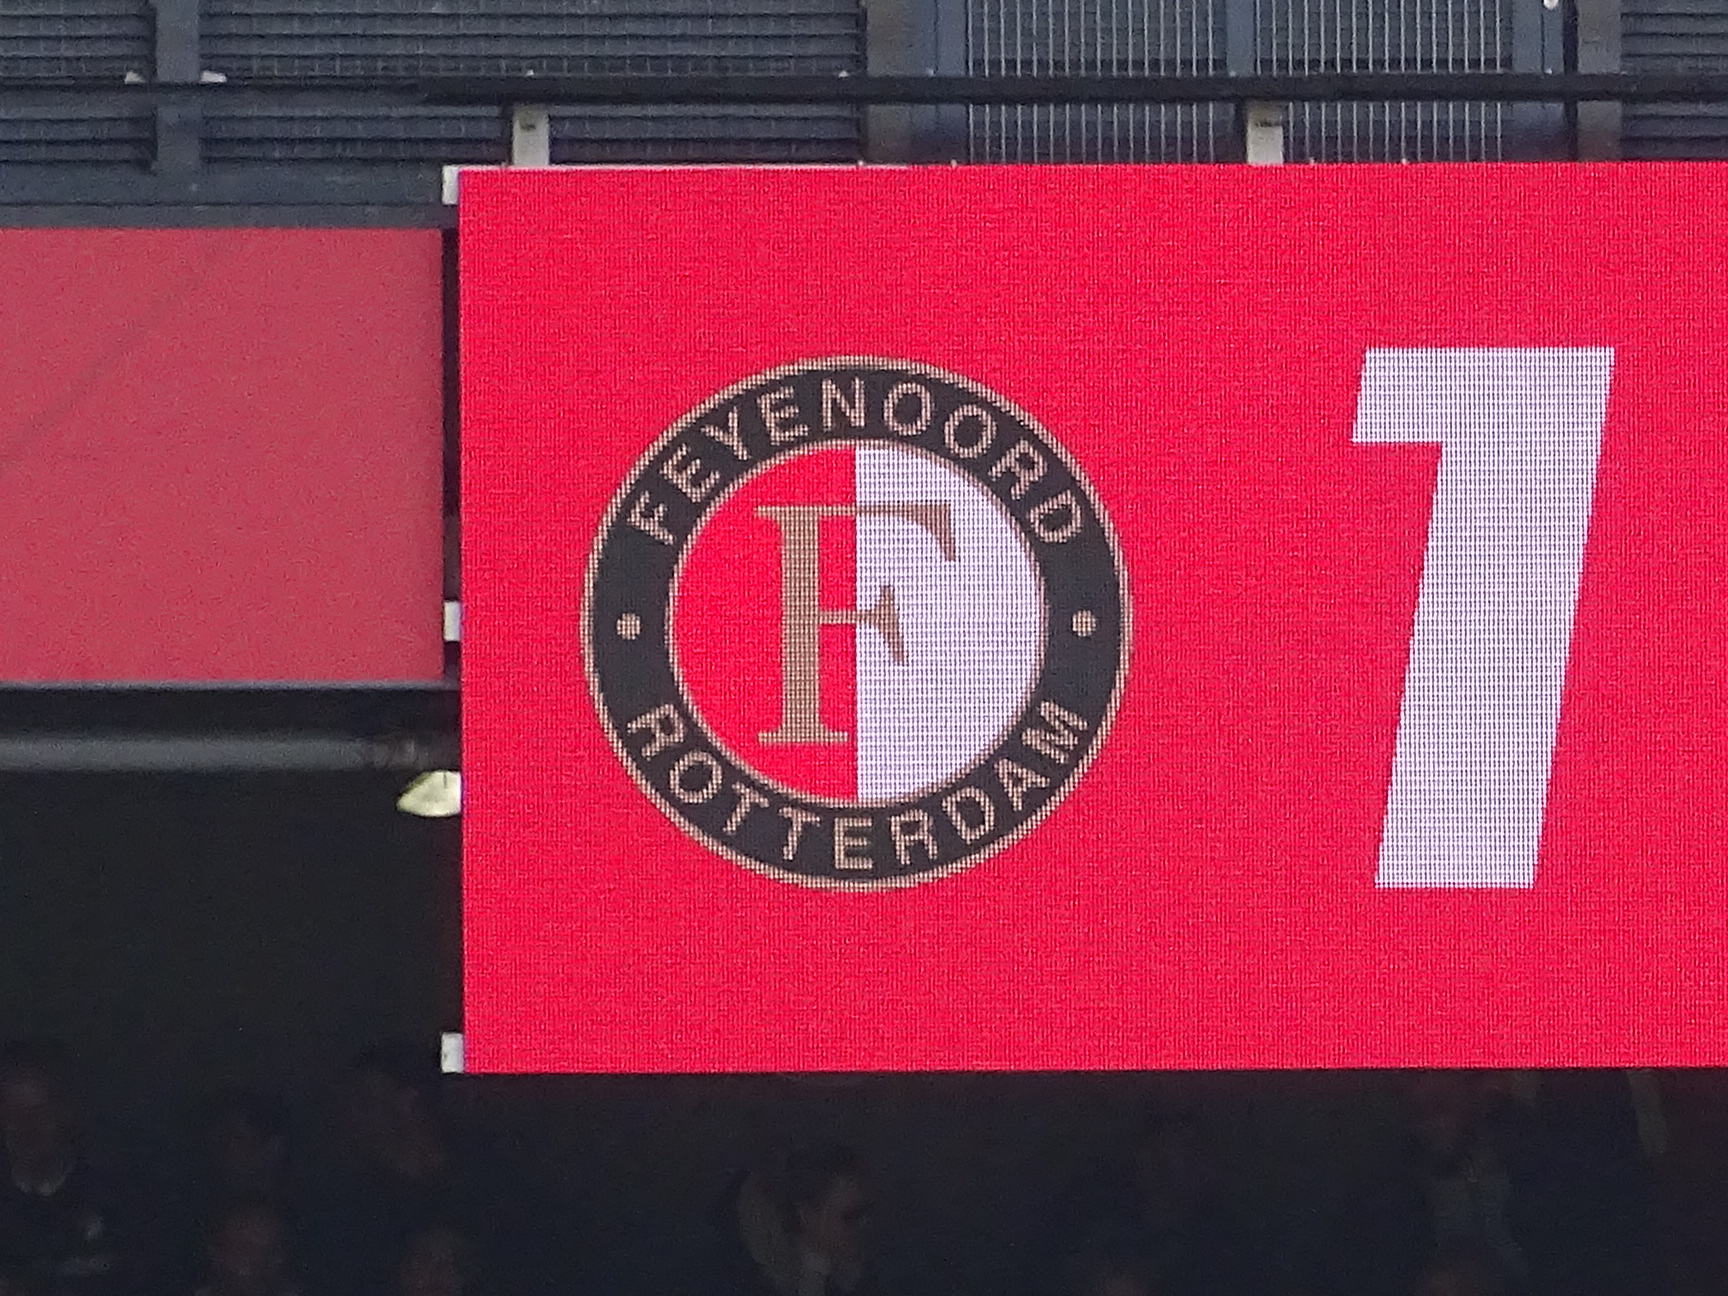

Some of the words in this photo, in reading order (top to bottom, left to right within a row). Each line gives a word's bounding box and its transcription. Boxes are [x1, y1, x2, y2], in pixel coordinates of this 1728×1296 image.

[627, 377, 1083, 547] FEYENOORD
[757, 504, 957, 745] F
[1352, 346, 1616, 888] 1
[626, 700, 1089, 871] ROTTERDAM
